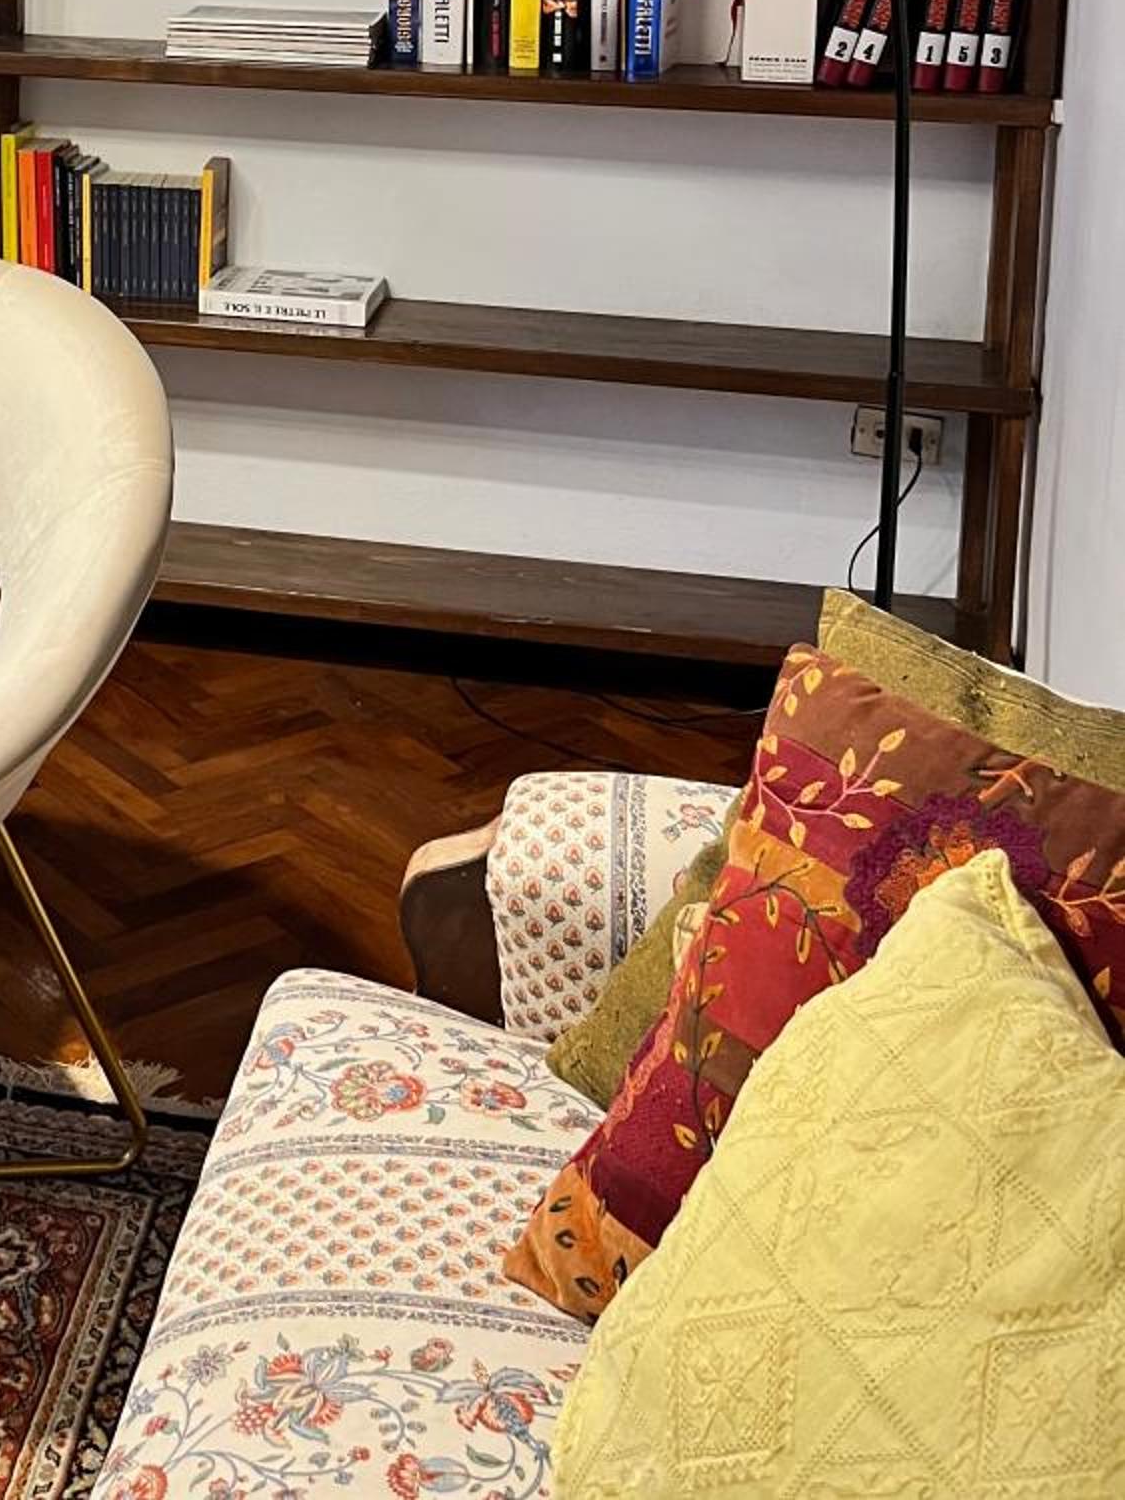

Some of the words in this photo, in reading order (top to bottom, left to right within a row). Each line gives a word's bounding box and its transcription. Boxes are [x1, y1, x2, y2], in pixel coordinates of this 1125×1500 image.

[835, 40, 848, 58] 2
[863, 43, 875, 60] 4
[925, 45, 934, 62] 1
[958, 46, 968, 63] 5
[990, 47, 1001, 64] 3
[225, 303, 250, 314] SOLE
[314, 309, 326, 320] LE
